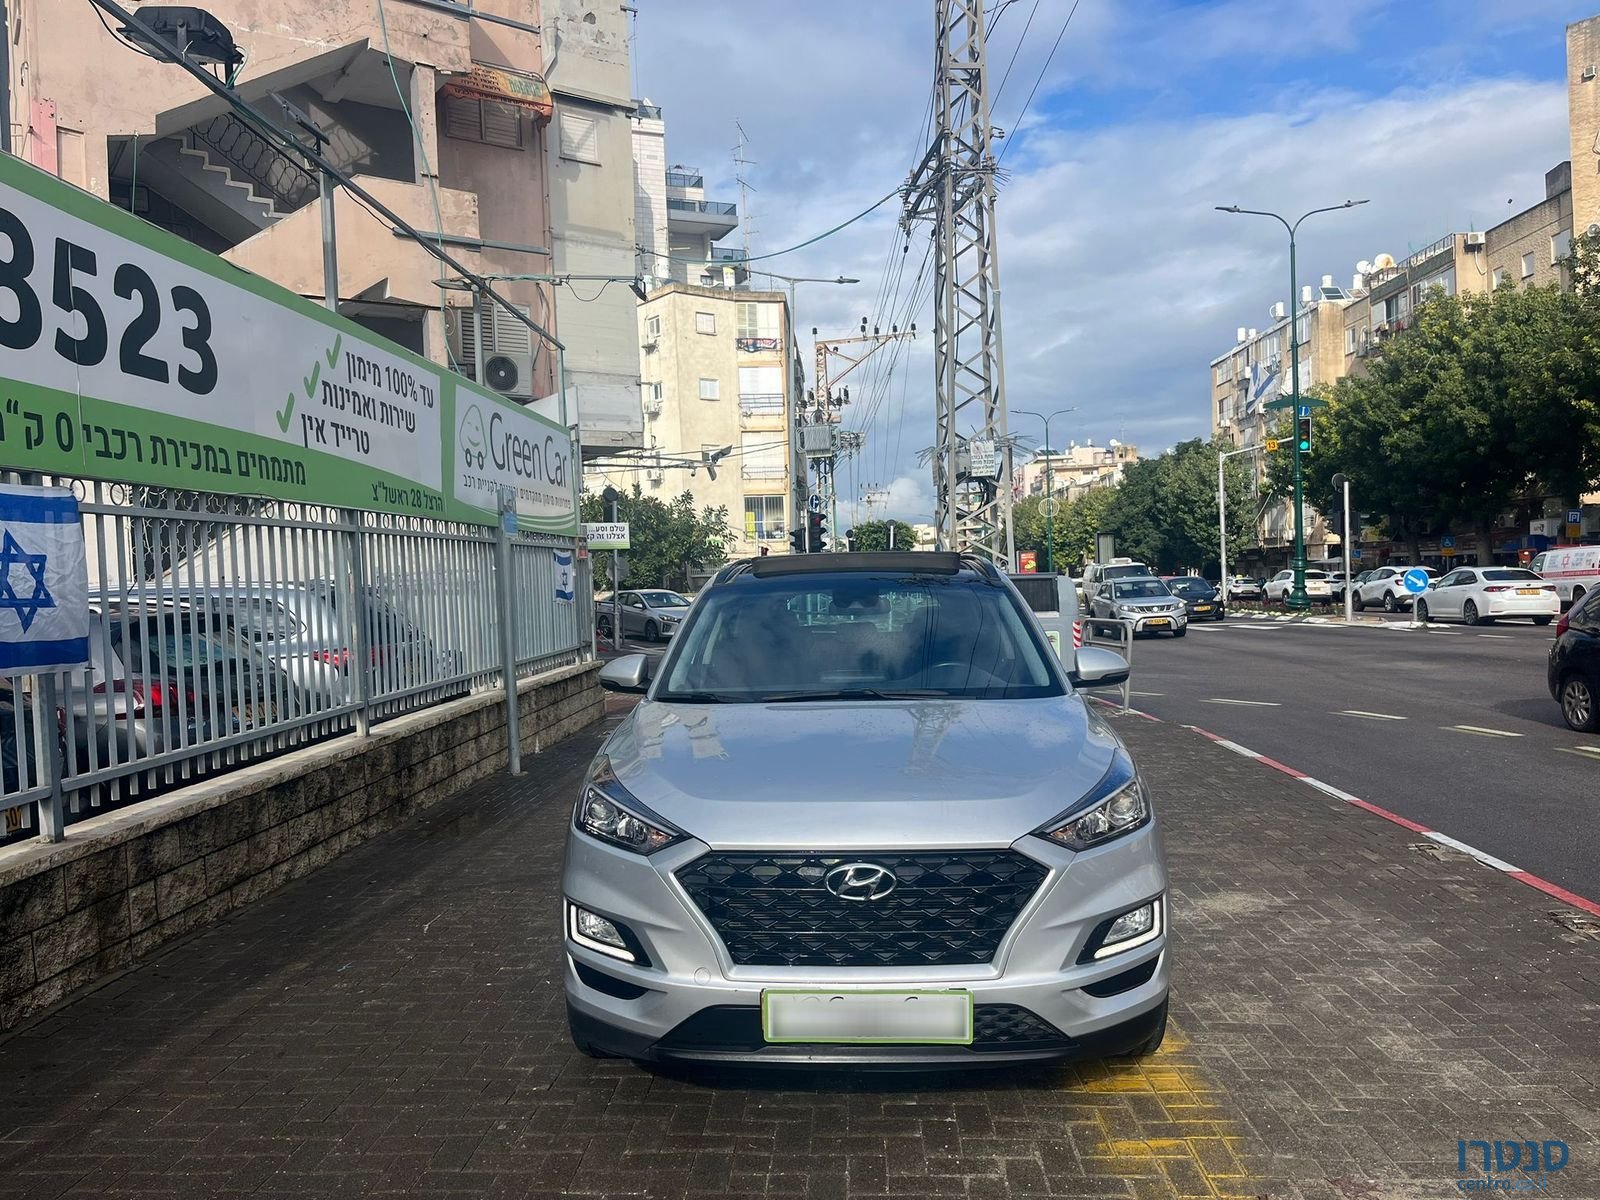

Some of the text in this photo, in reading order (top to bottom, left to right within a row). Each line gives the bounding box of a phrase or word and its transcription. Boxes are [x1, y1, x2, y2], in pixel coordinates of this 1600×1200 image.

[0, 207, 218, 395] 8523
[346, 351, 434, 409] עד 100% מימון
[321, 380, 416, 433] שירות ואמינות
[0, 398, 306, 486] מתמחים במכירת רכבי 0 ק"
[301, 413, 370, 455] טרייד אין
[489, 412, 567, 488] Green Car
[410, 487, 422, 508] 28
[423, 489, 443, 512] הרצל
[463, 474, 476, 489] רכב
[606, 532, 626, 540] אצלנו
[609, 525, 625, 533] שלם
